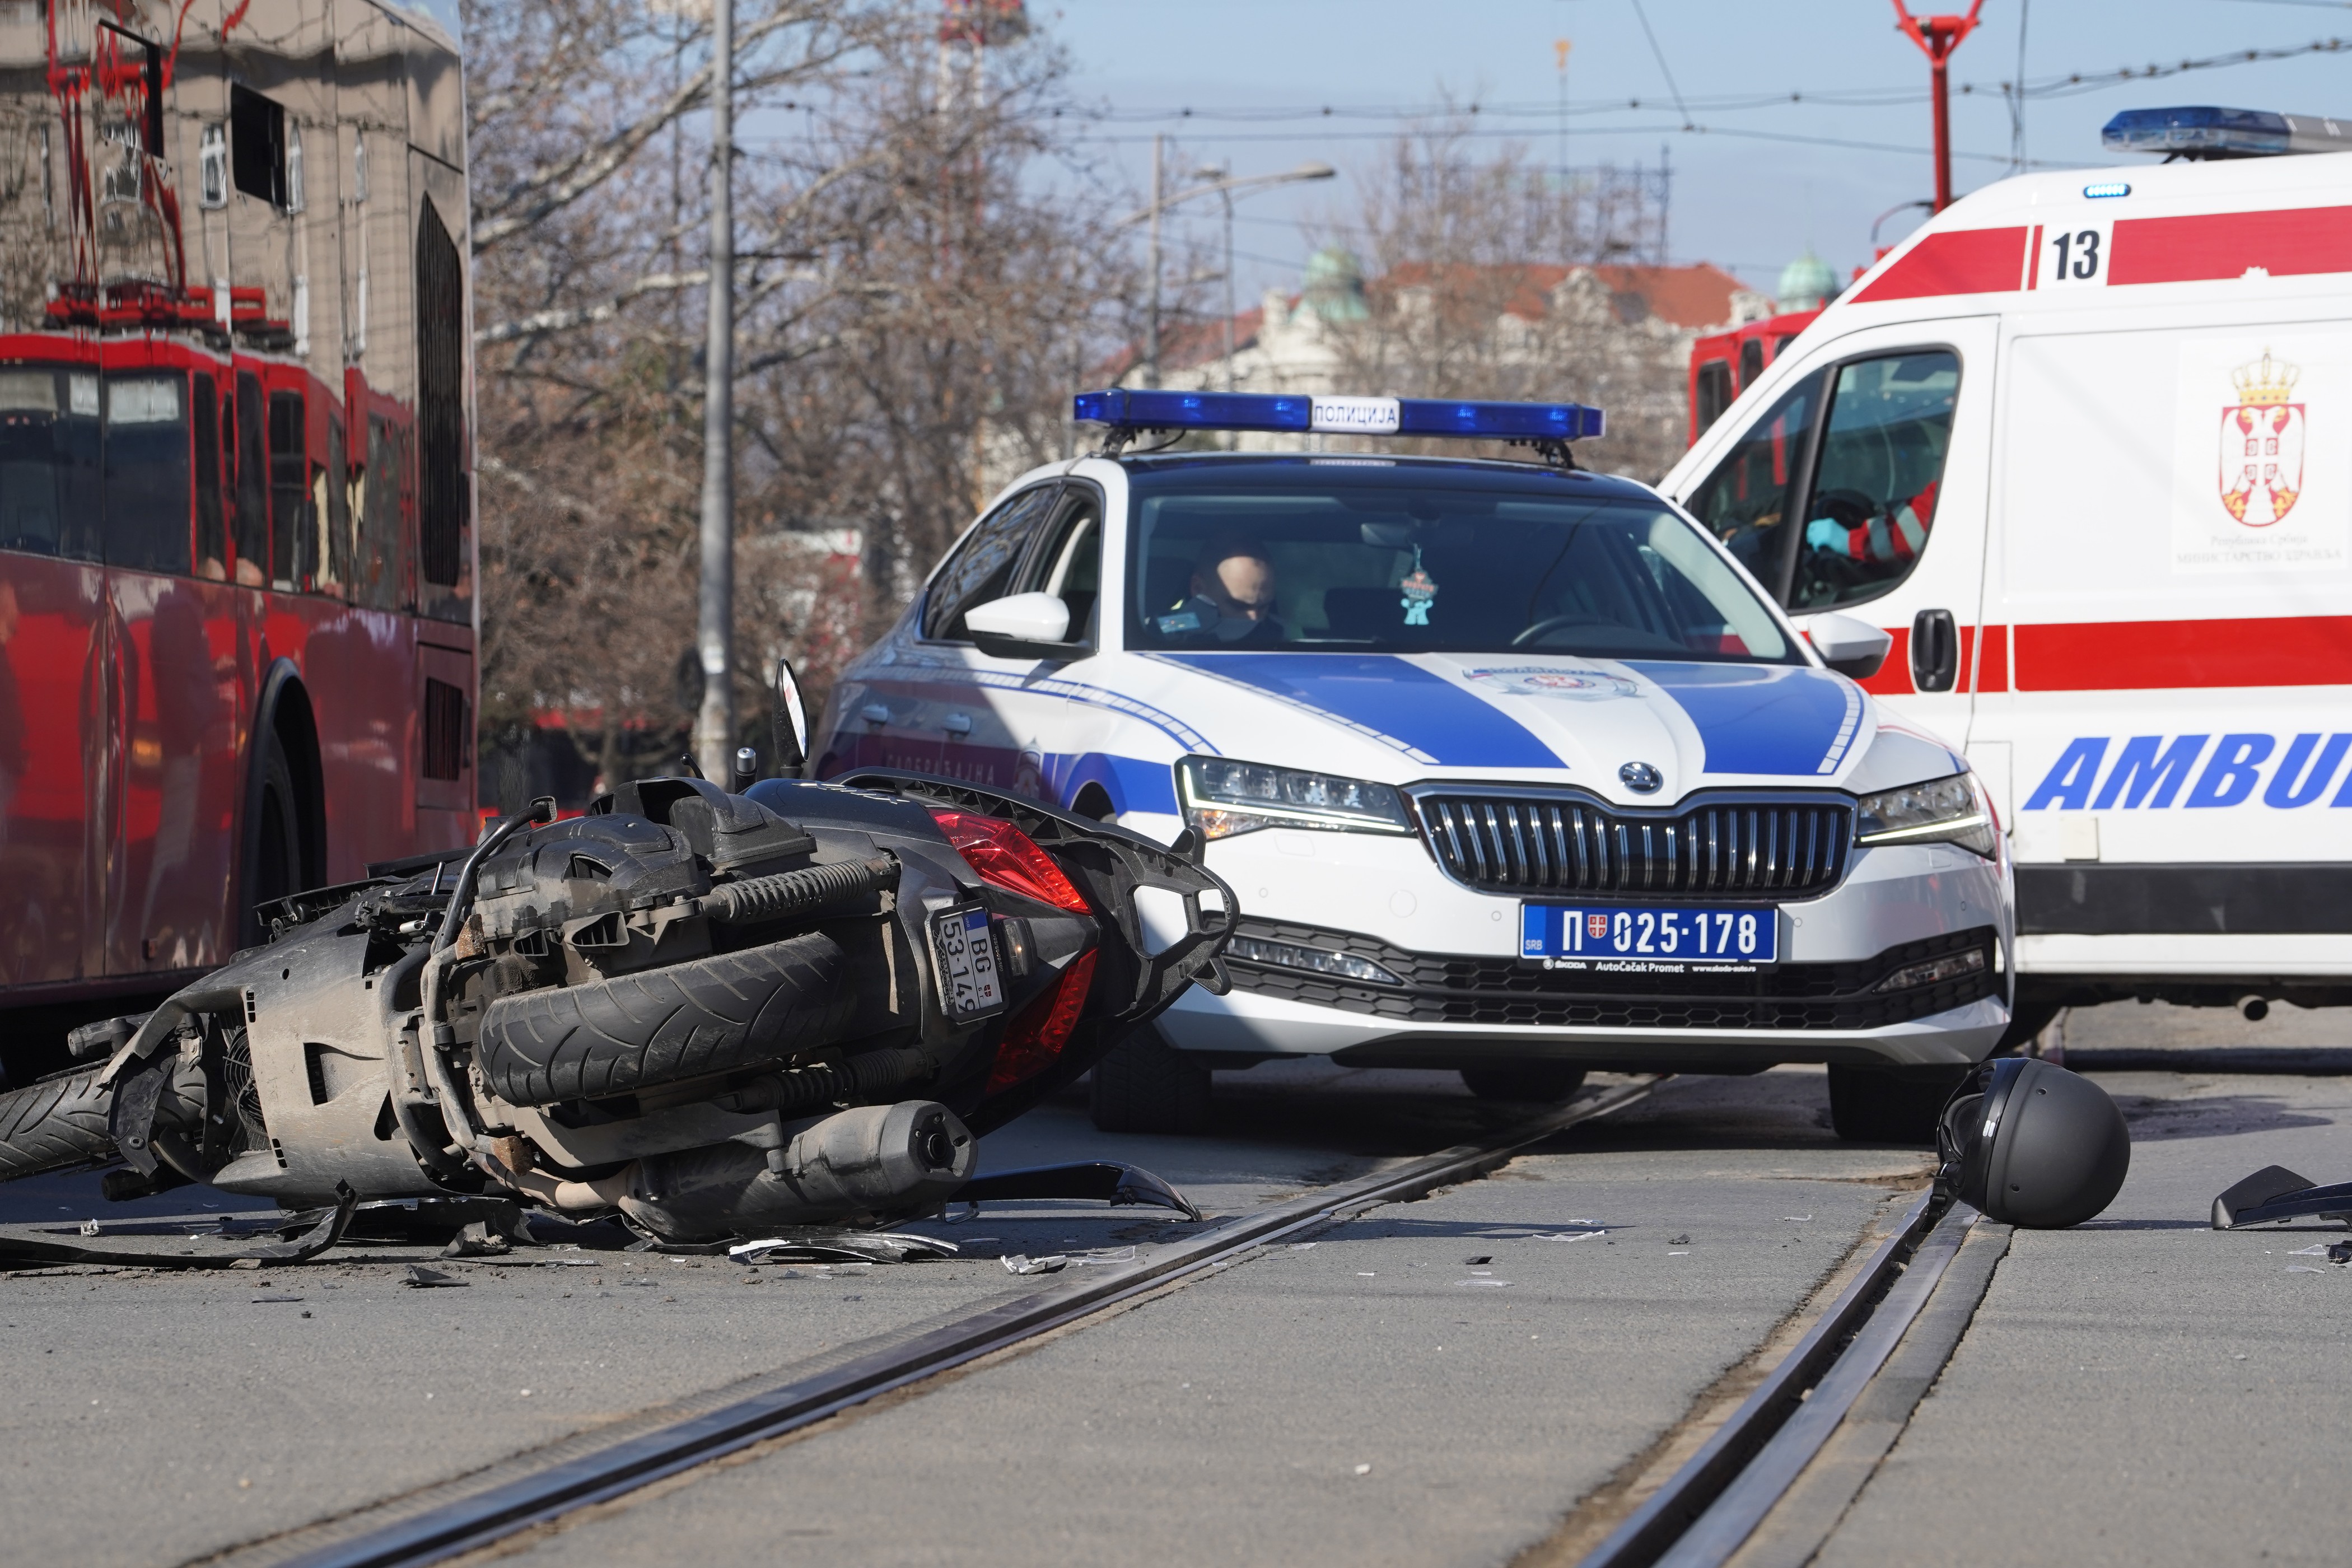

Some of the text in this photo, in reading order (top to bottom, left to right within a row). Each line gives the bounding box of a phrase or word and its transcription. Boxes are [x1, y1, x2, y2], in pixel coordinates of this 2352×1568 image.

[2053, 230, 2100, 281] 13
[1314, 406, 1396, 427] ПОЛИЦИЈА
[1525, 939, 1543, 950] SRB
[1562, 911, 1583, 951] П
[944, 921, 976, 1012] 53-149
[970, 938, 991, 973] BG
[1555, 960, 1587, 969] ŠKODA
[1595, 960, 1685, 973] AutoČačak Promet
